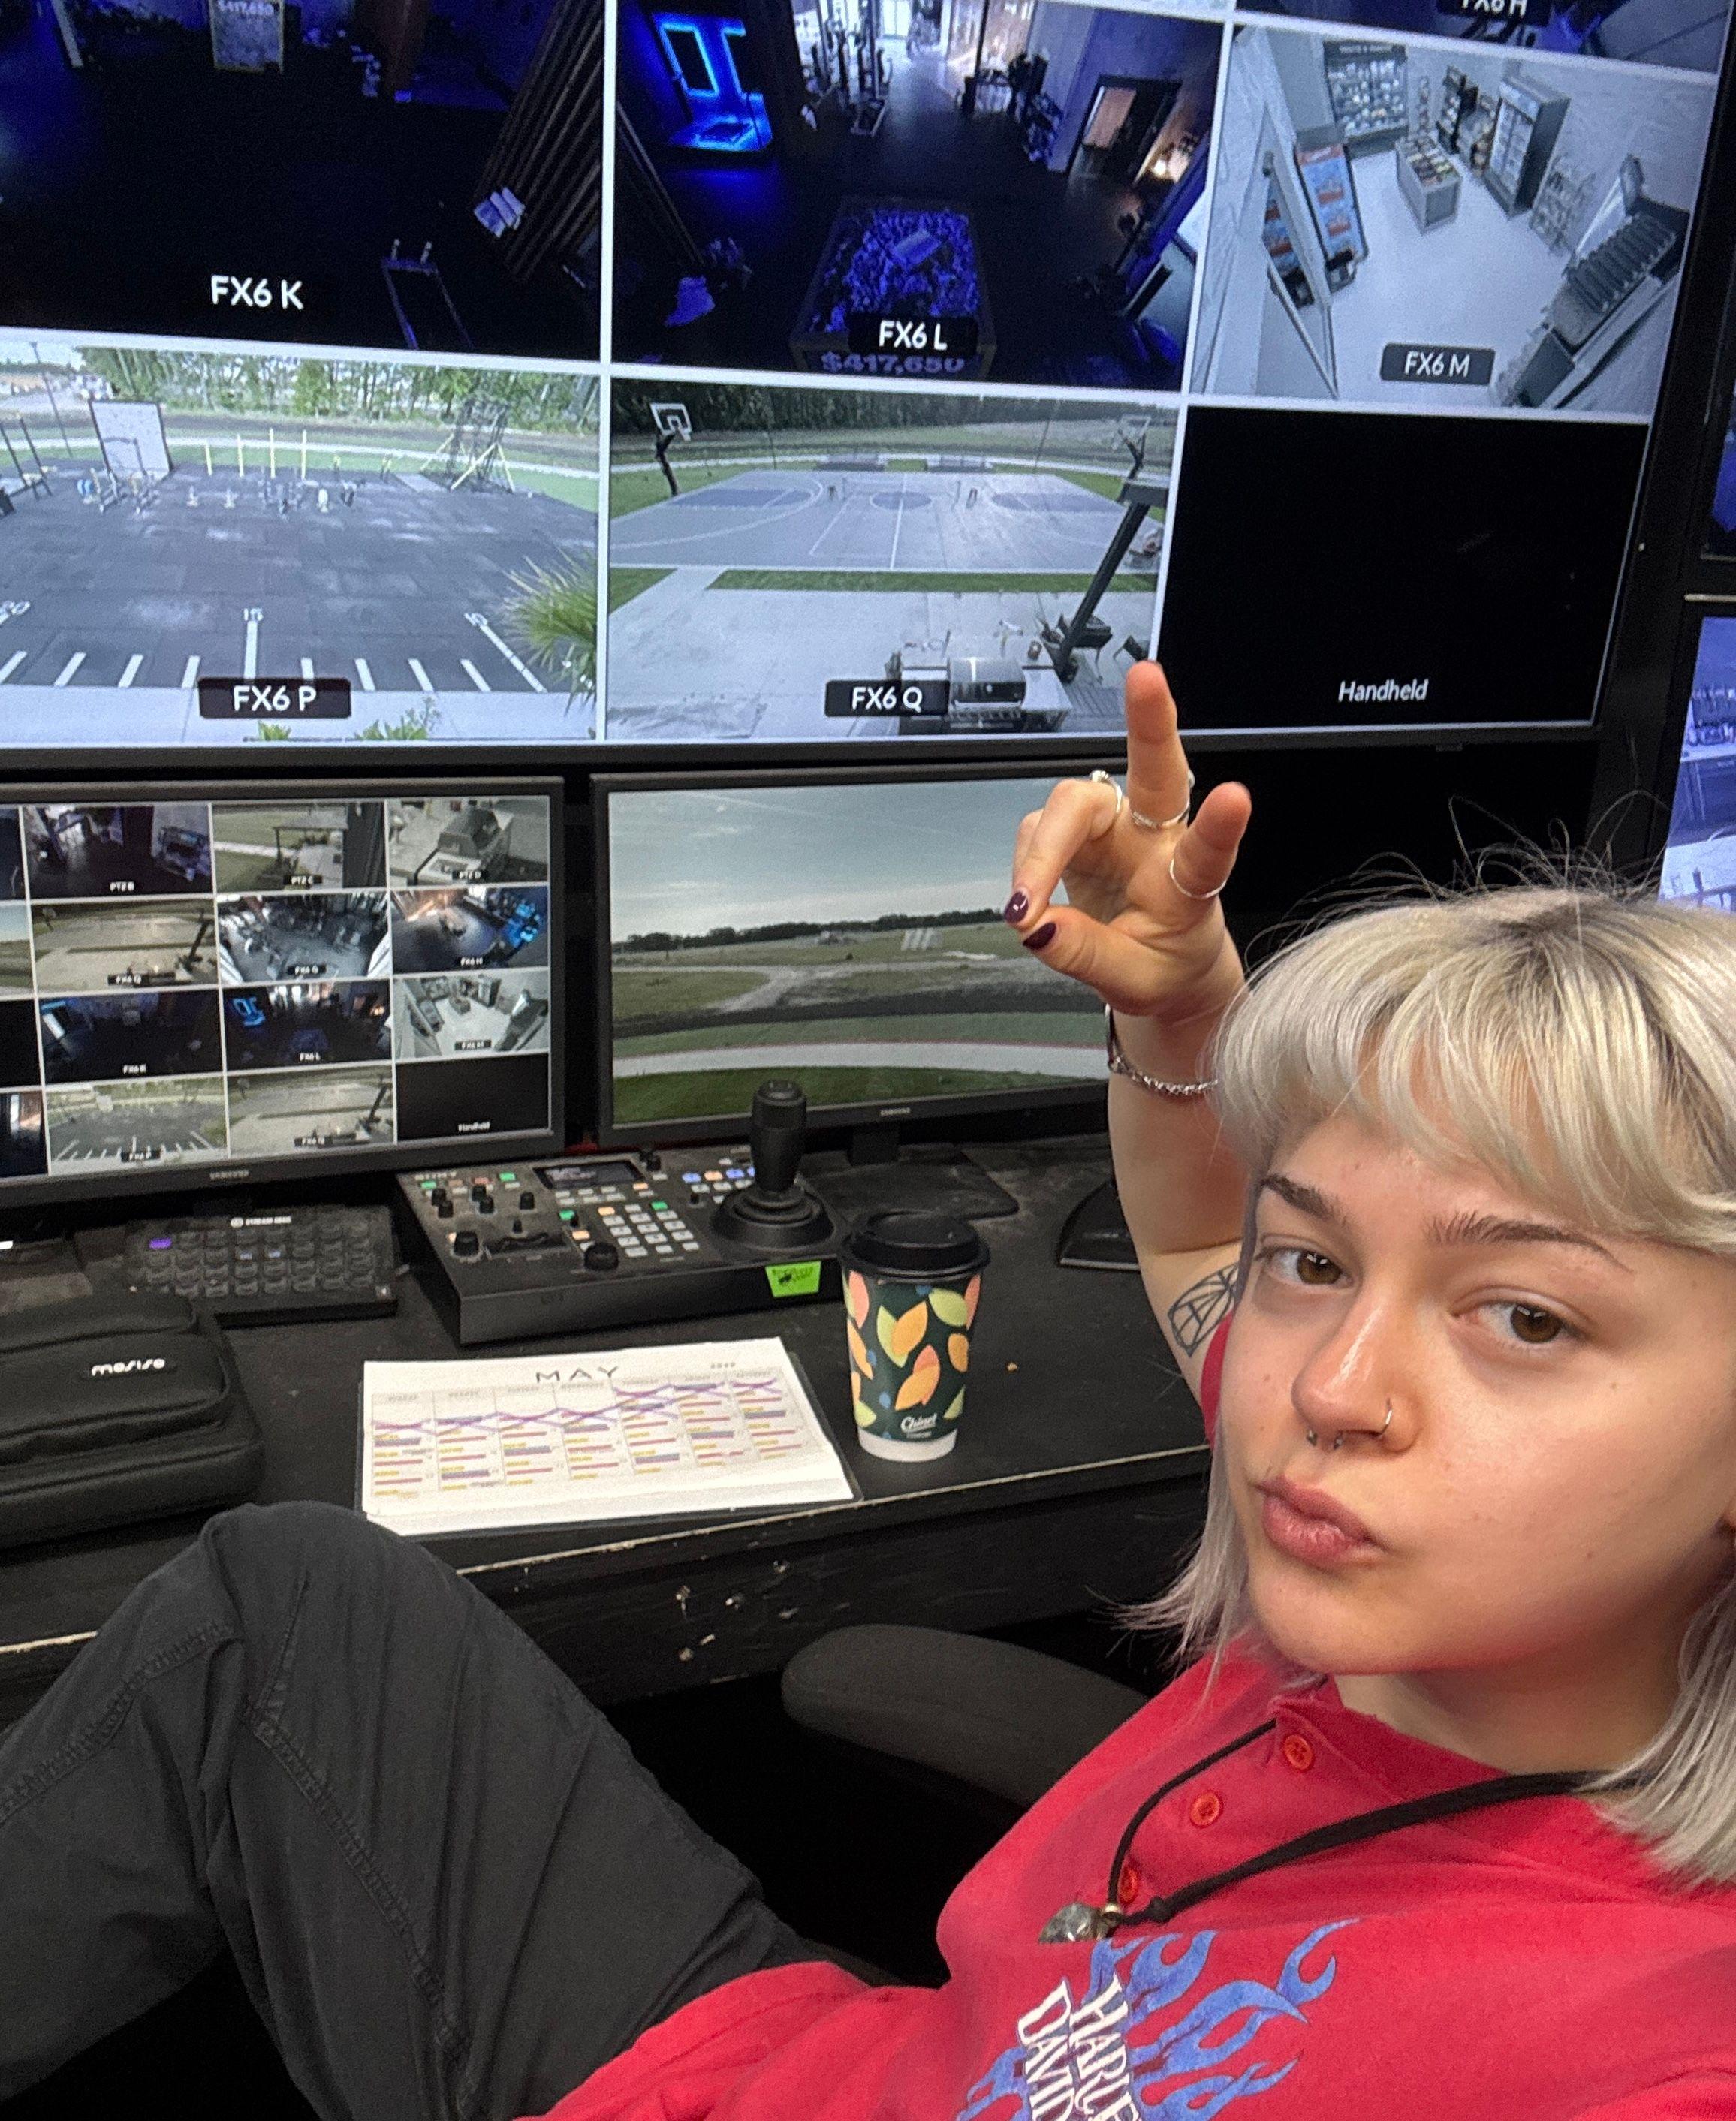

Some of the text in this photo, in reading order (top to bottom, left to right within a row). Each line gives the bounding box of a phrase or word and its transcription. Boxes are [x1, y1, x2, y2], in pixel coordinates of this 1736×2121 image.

[211, 274, 303, 310] FX6 K
[879, 320, 948, 351] FX6 L
[1404, 351, 1470, 377] FX6 M
[234, 685, 316, 711] FX6 P
[852, 686, 923, 713] FX6 Q
[1338, 679, 1429, 702] Handheld
[536, 1366, 618, 1383] MAY
